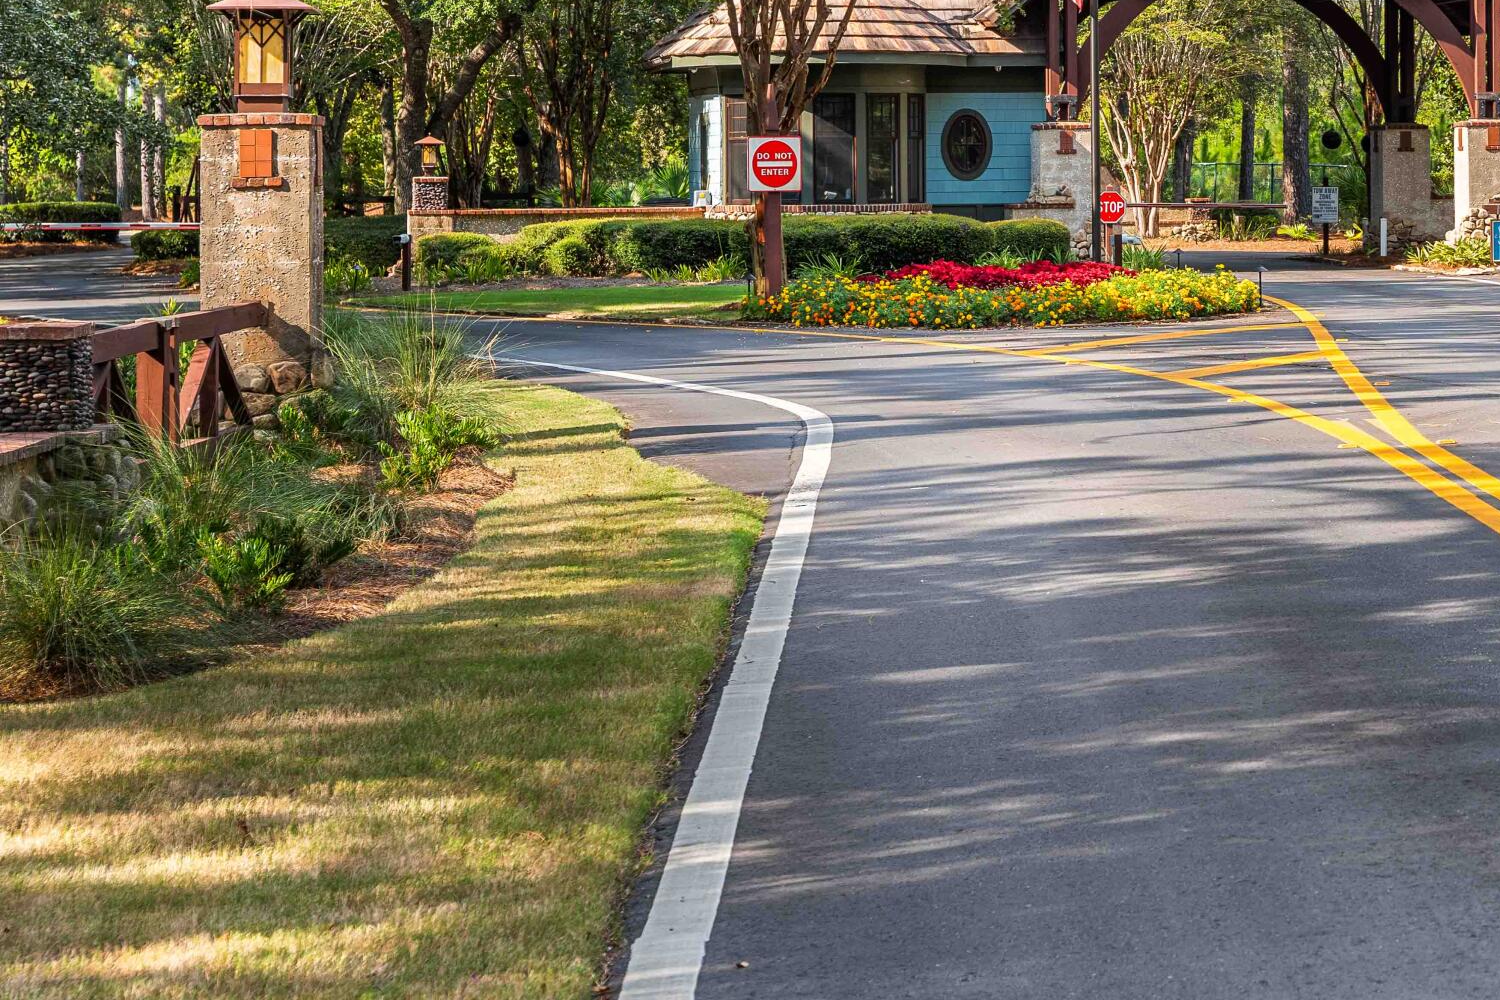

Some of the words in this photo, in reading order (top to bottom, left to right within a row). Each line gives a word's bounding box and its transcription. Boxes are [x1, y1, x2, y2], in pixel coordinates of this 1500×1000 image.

[757, 152, 770, 160] DO
[774, 152, 792, 160] NOT
[761, 168, 789, 176] ENTER
